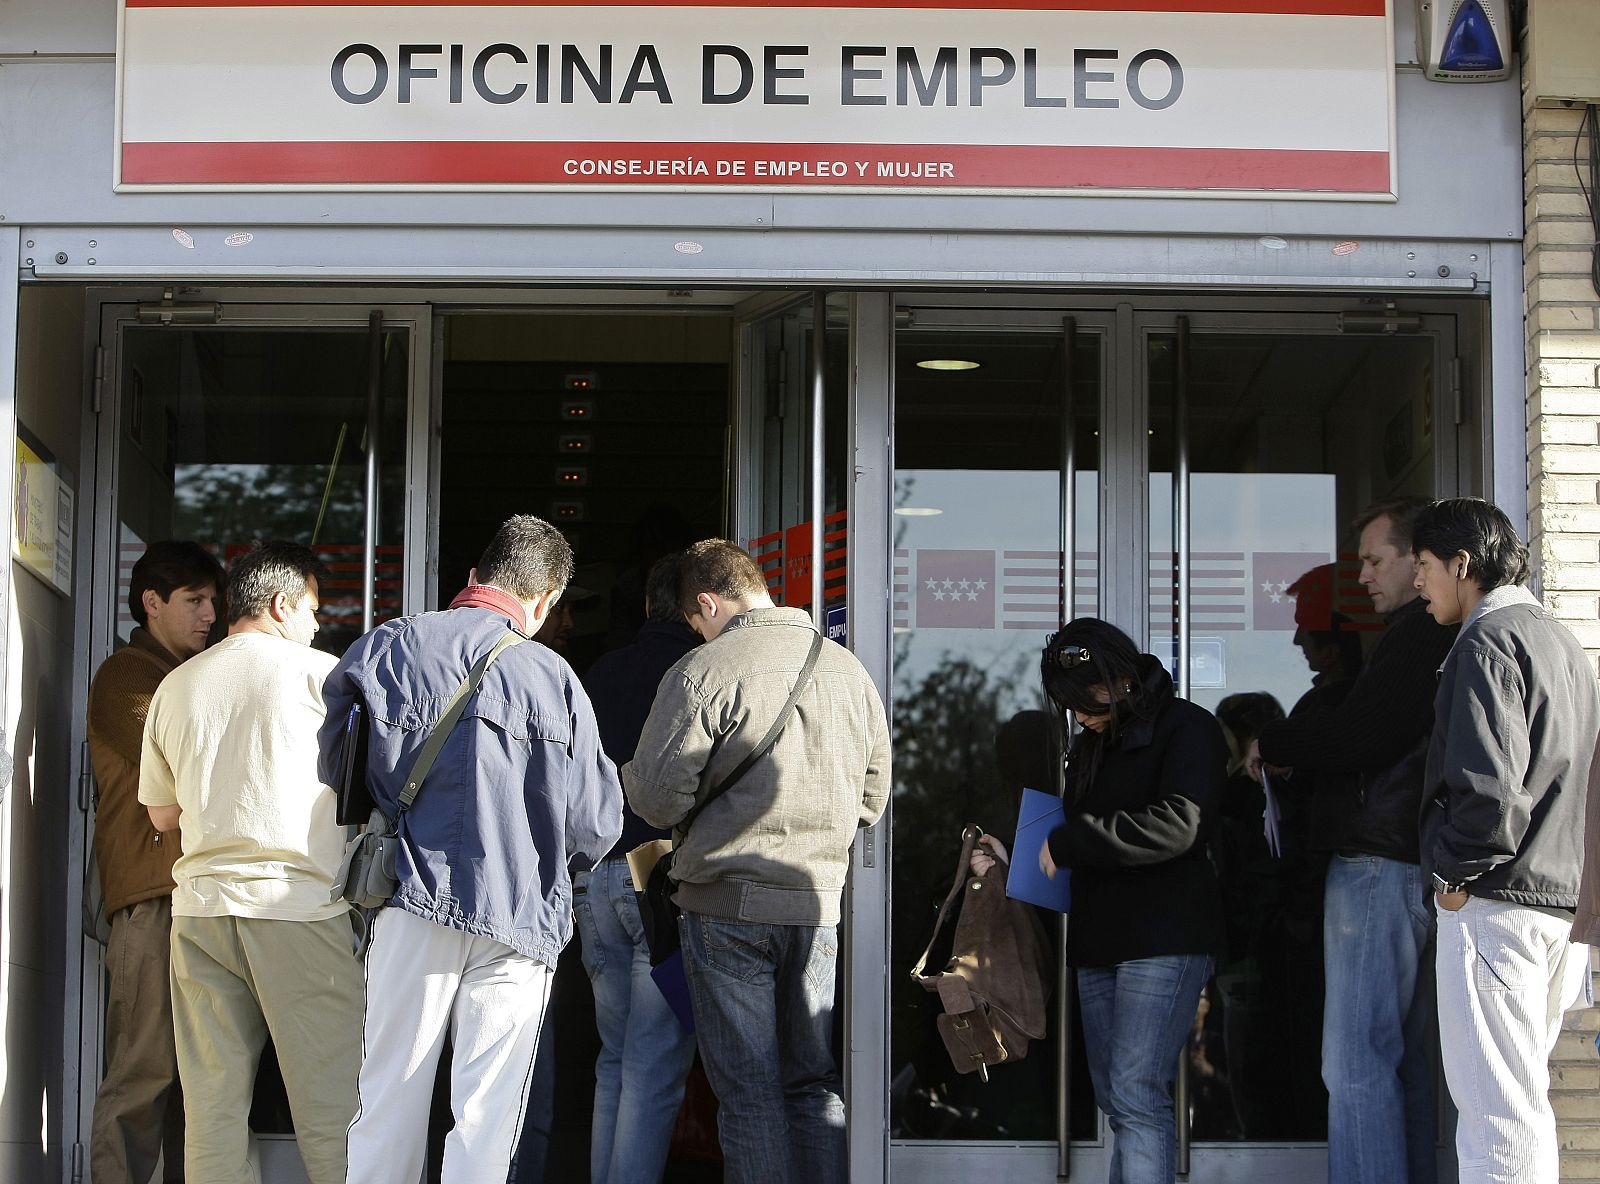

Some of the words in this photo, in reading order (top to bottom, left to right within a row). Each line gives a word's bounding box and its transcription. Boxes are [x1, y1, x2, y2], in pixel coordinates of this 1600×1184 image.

[331, 43, 673, 104] OFICINA
[701, 44, 809, 104] DE
[841, 46, 1184, 110] EMPLEO
[563, 157, 709, 176] CONSEJERÍA
[716, 160, 746, 176] DE
[754, 161, 848, 177] EMPLEO
[854, 161, 869, 177] Y
[877, 162, 954, 178] MUJER
[829, 623, 846, 639] EMPU
